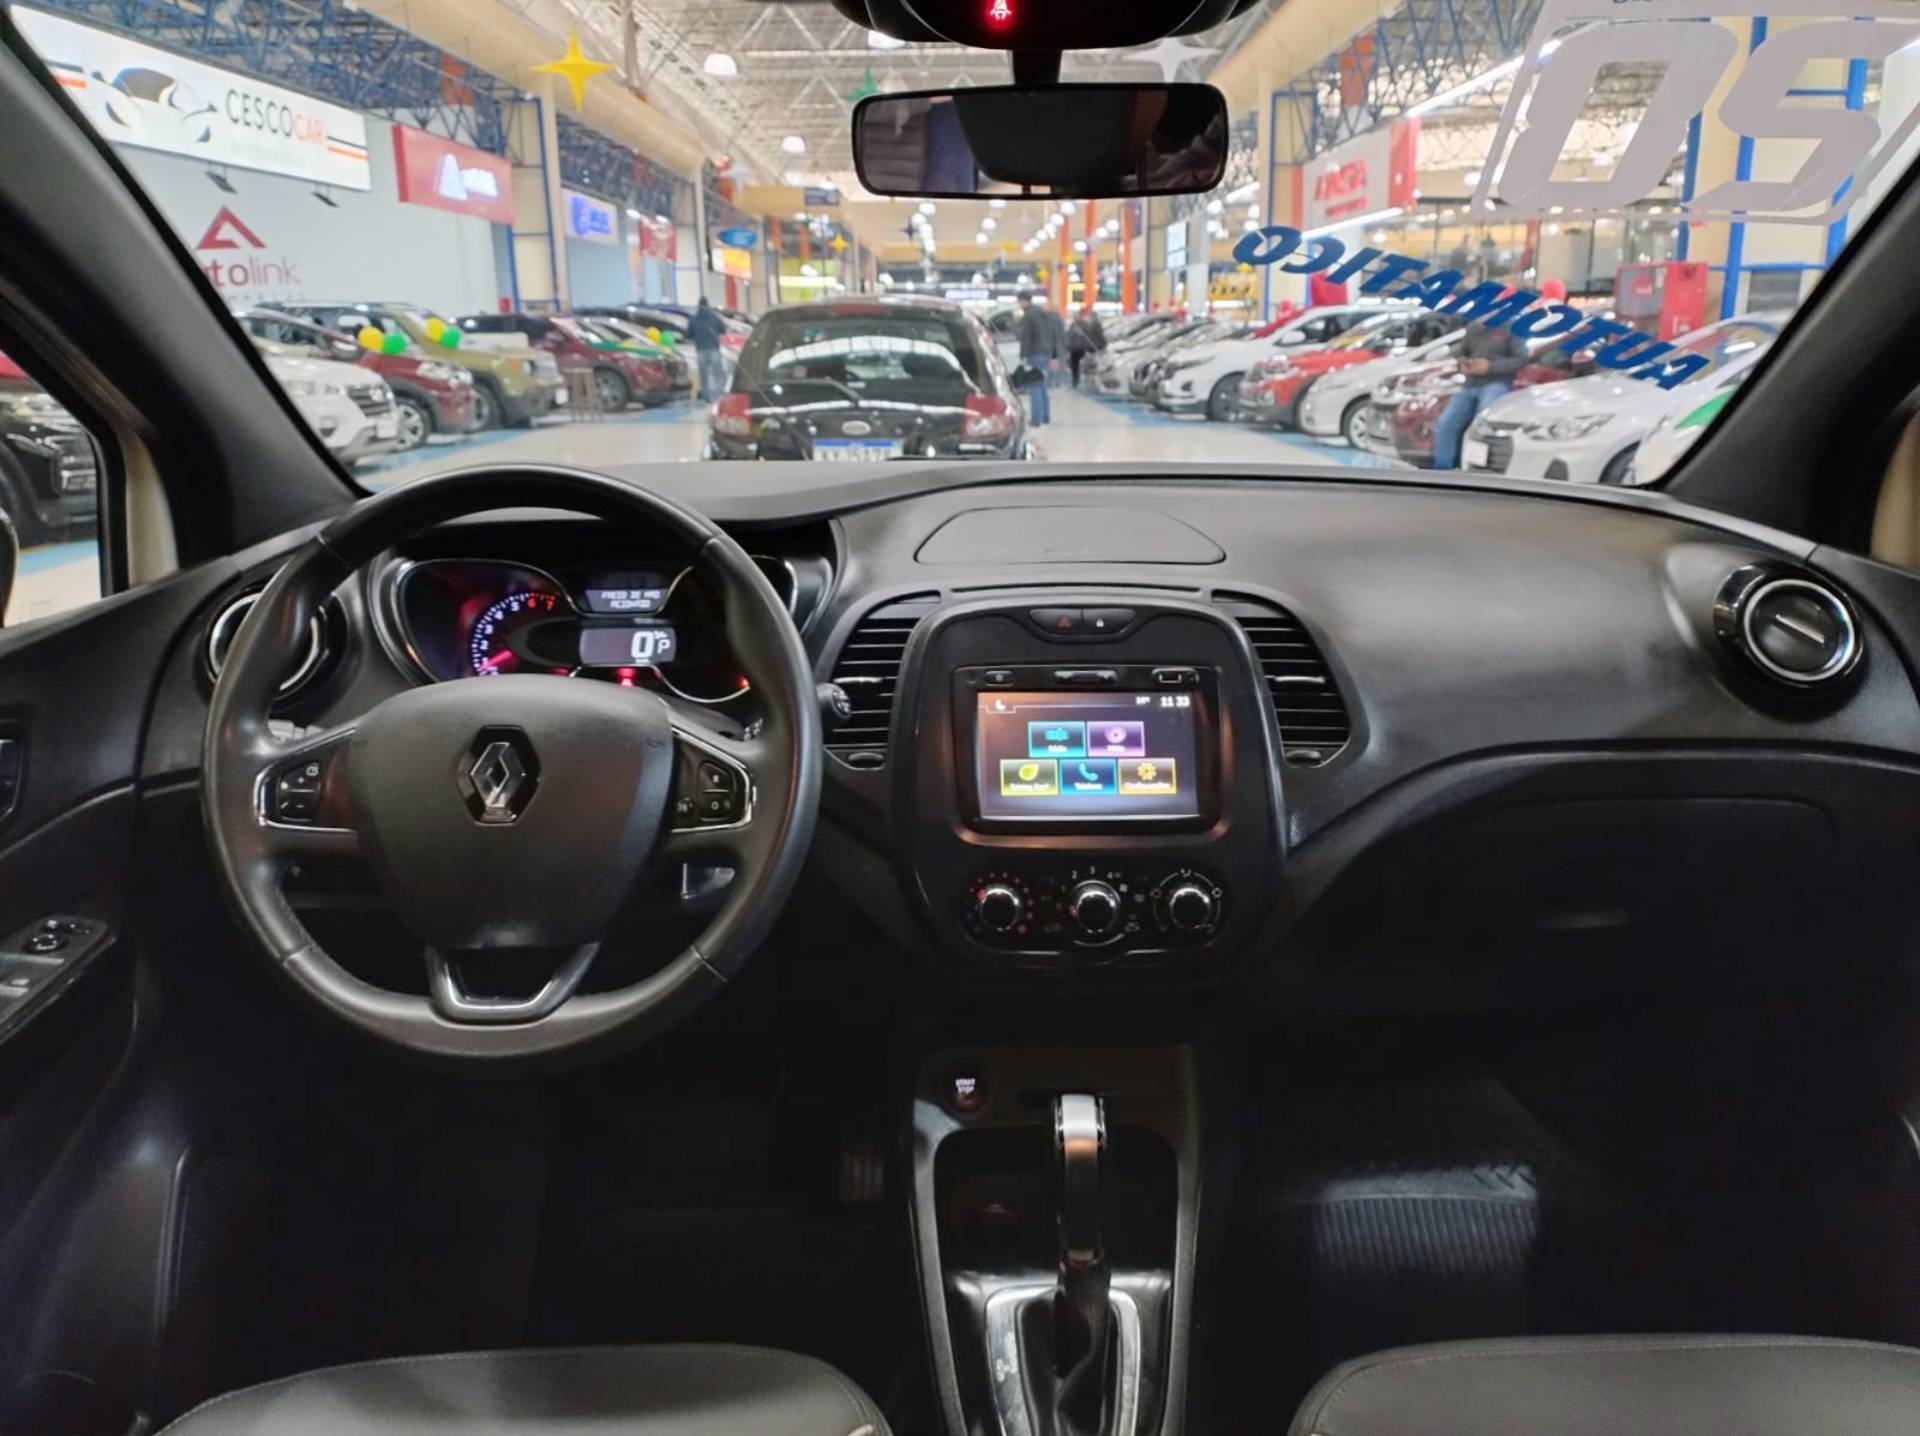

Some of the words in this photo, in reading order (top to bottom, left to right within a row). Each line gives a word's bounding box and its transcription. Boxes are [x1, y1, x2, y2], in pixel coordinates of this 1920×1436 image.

[226, 89, 324, 144] CESCOCAR
[630, 631, 655, 659] 0
[657, 638, 671, 654] P
